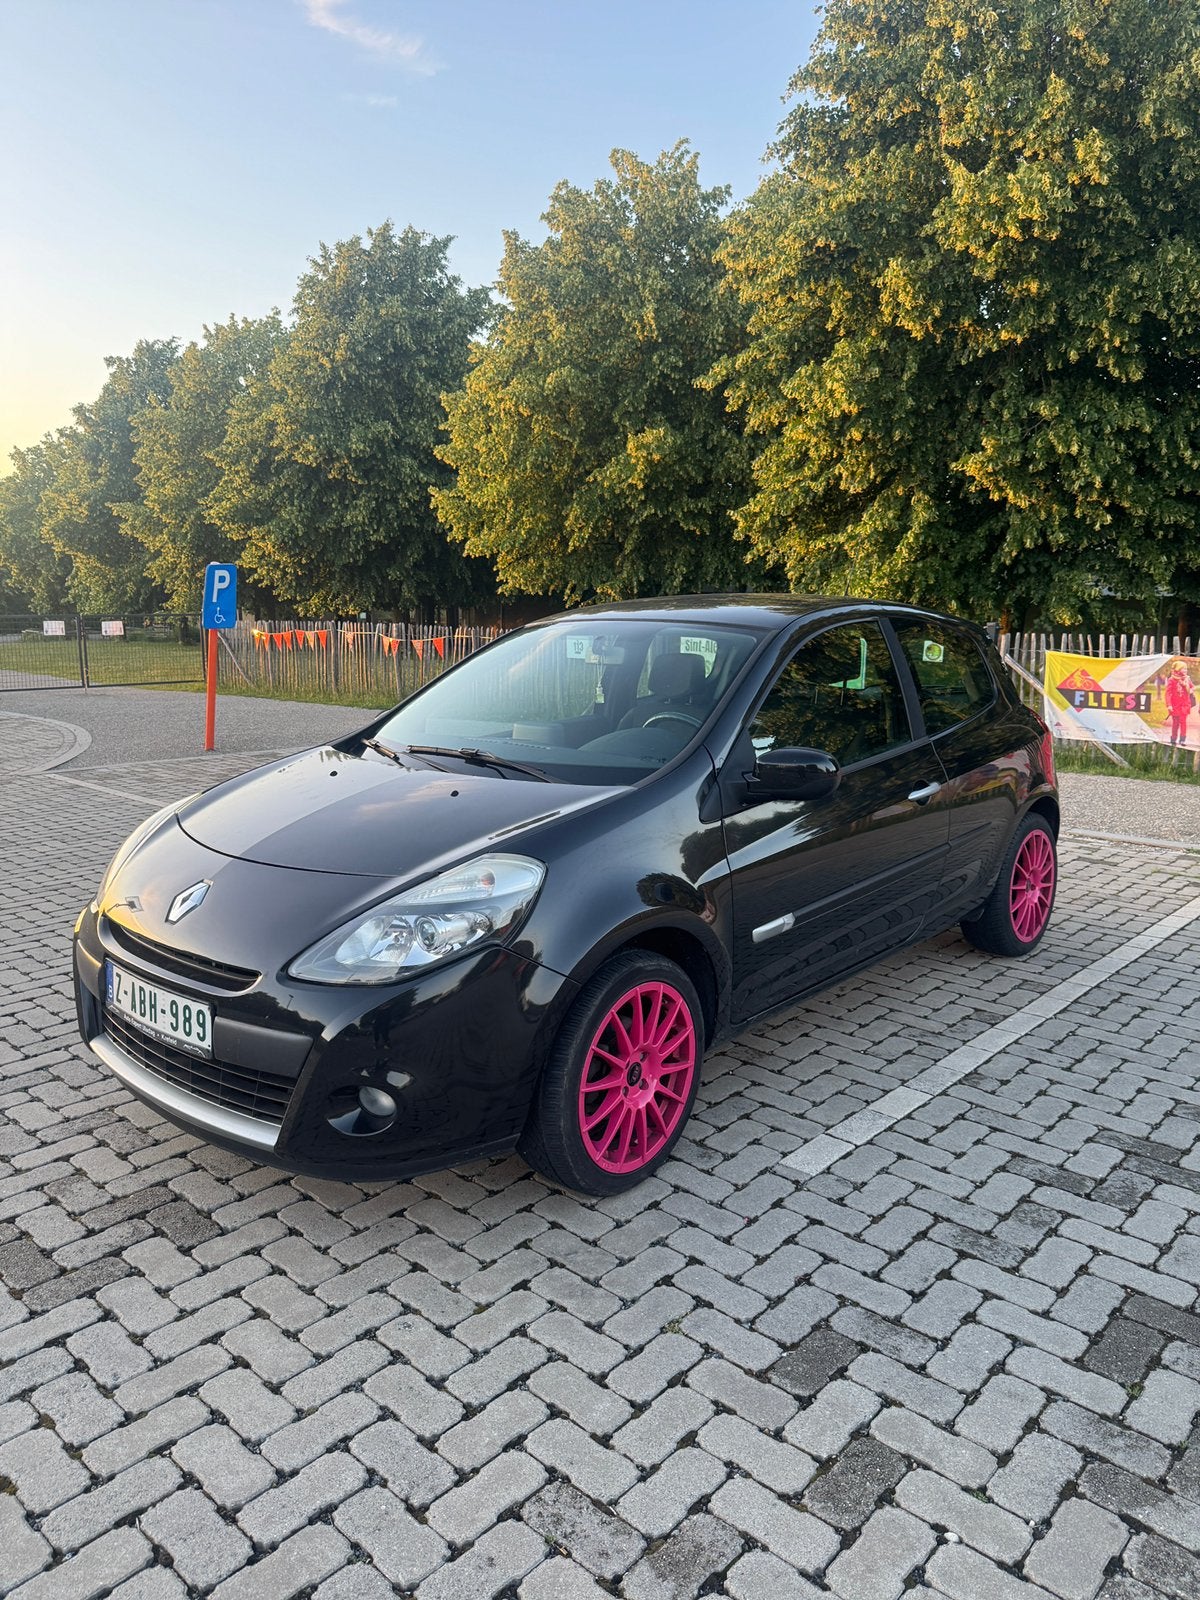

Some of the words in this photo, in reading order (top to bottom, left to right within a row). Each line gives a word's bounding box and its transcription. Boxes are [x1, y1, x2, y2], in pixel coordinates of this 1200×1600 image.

[212, 569, 231, 603] P
[1074, 690, 1148, 710] FLITS!
[115, 971, 207, 1042] Z-ABH-989
